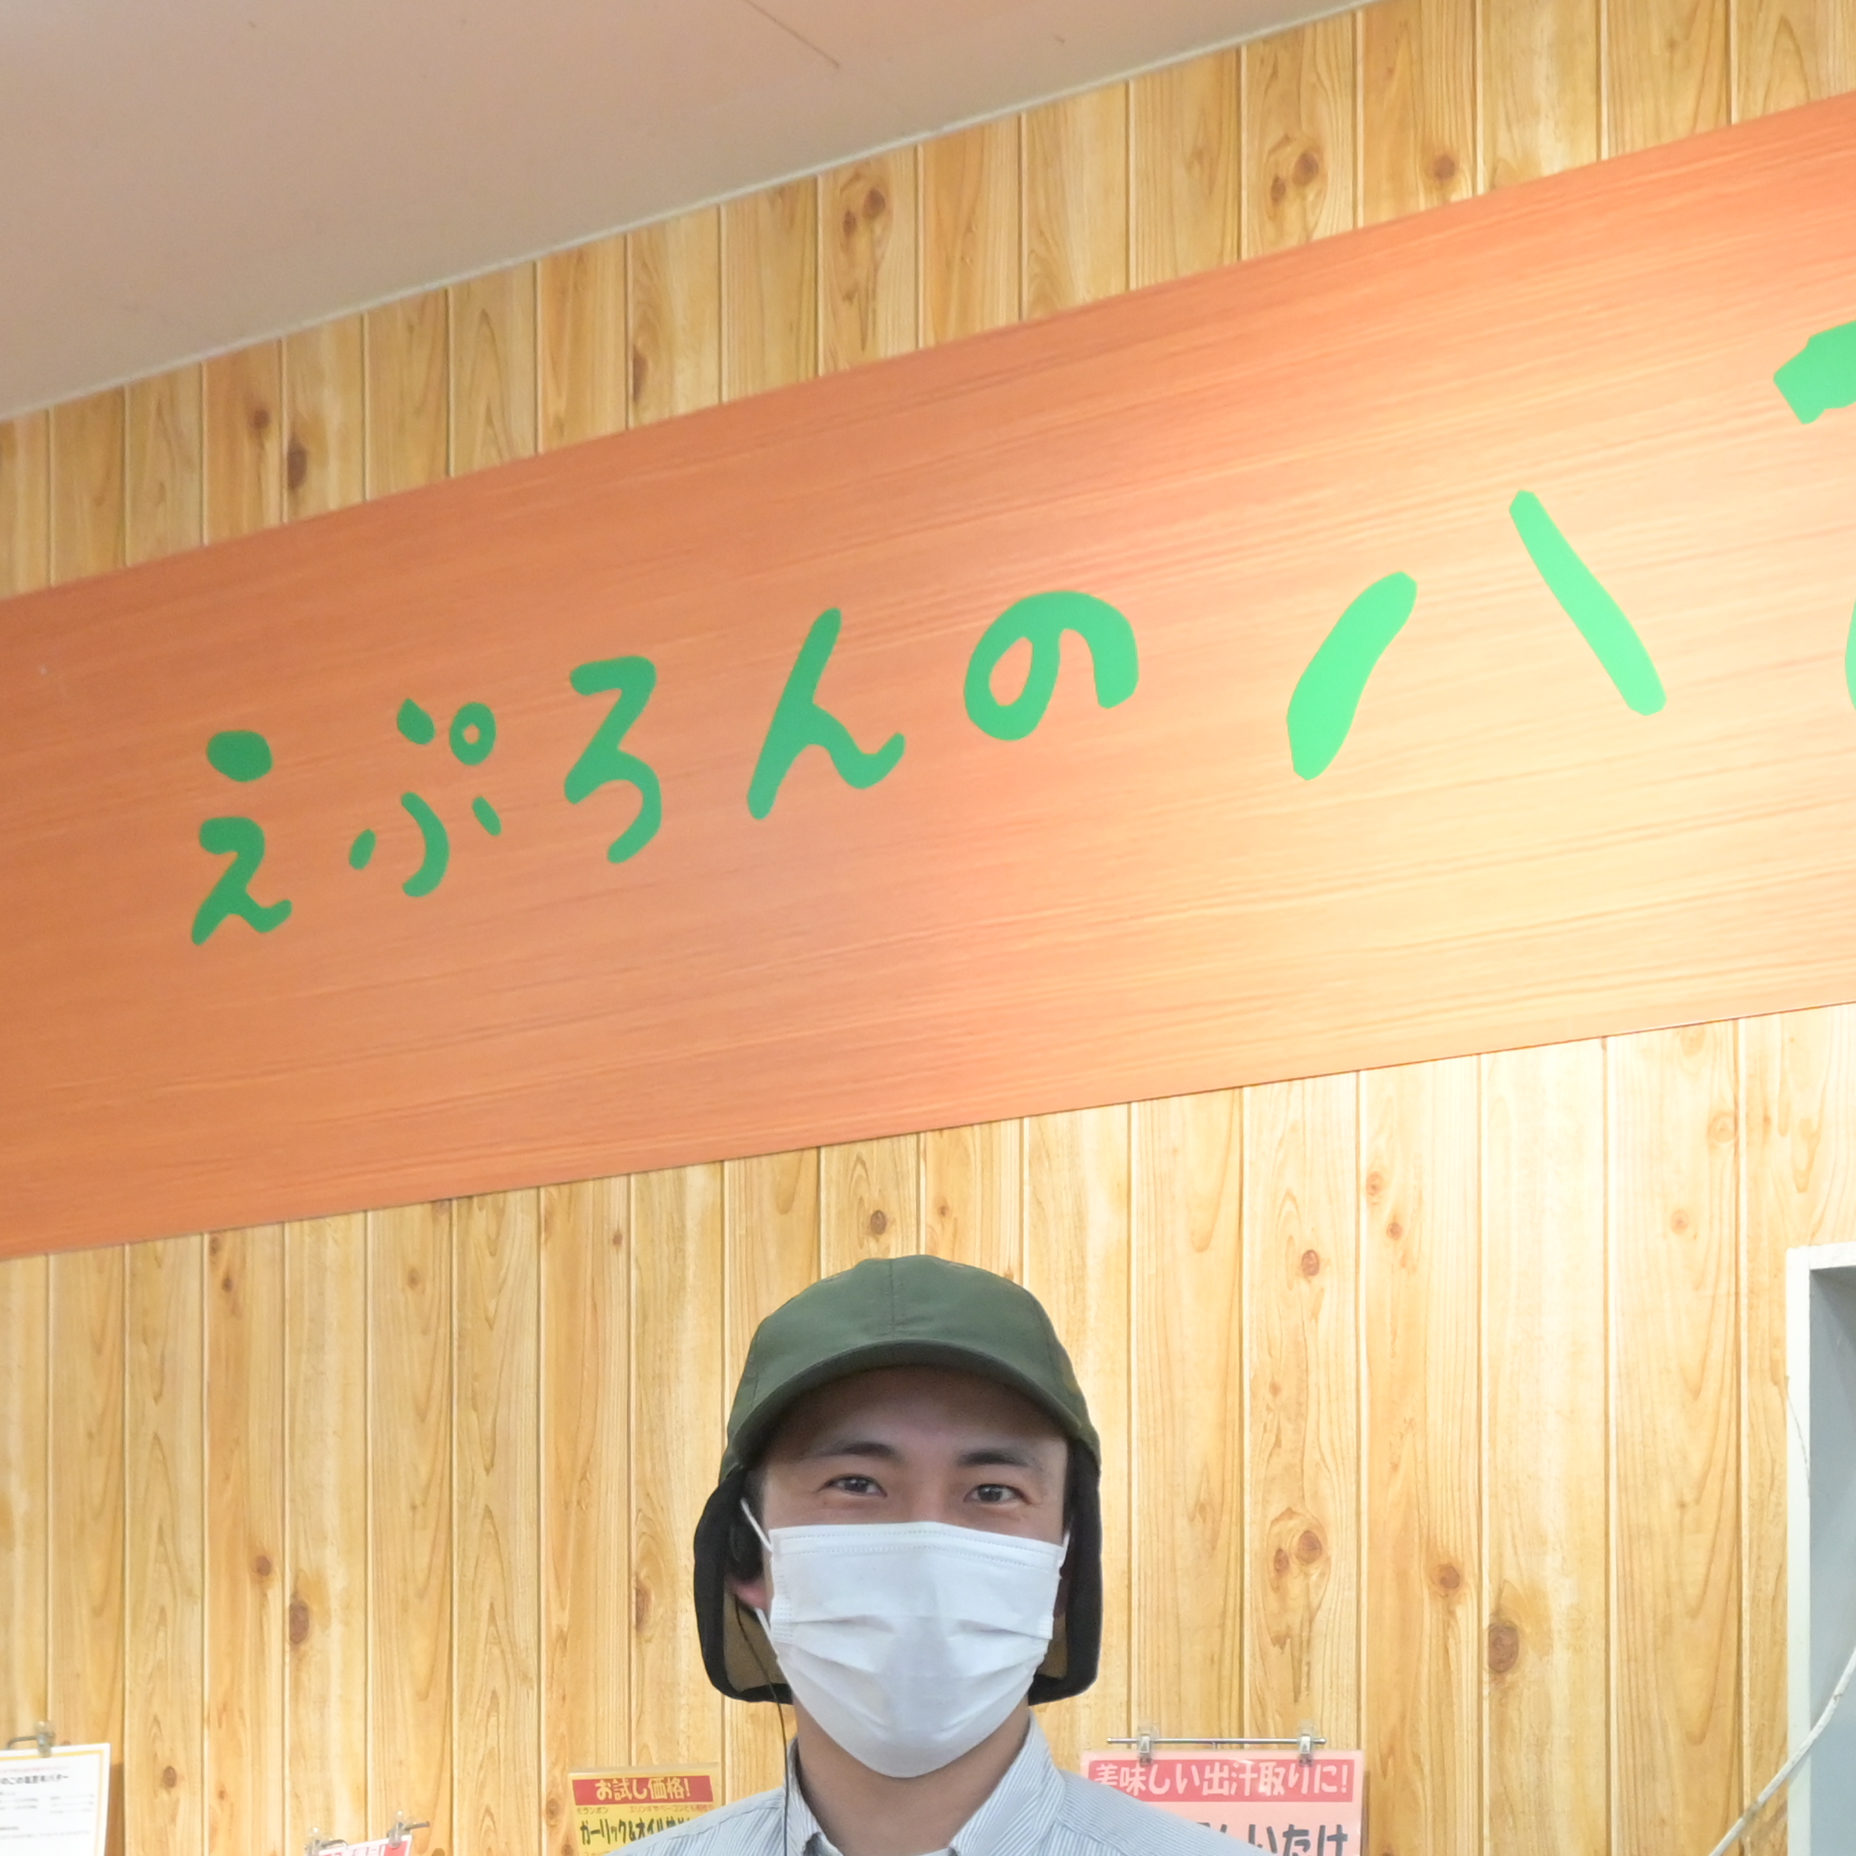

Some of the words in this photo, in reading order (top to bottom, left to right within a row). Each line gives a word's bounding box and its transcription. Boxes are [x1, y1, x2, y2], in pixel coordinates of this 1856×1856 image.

[595, 1777, 691, 1802] お試し価格!
[1094, 1762, 1349, 1797] 美味しい出汁取りに!
